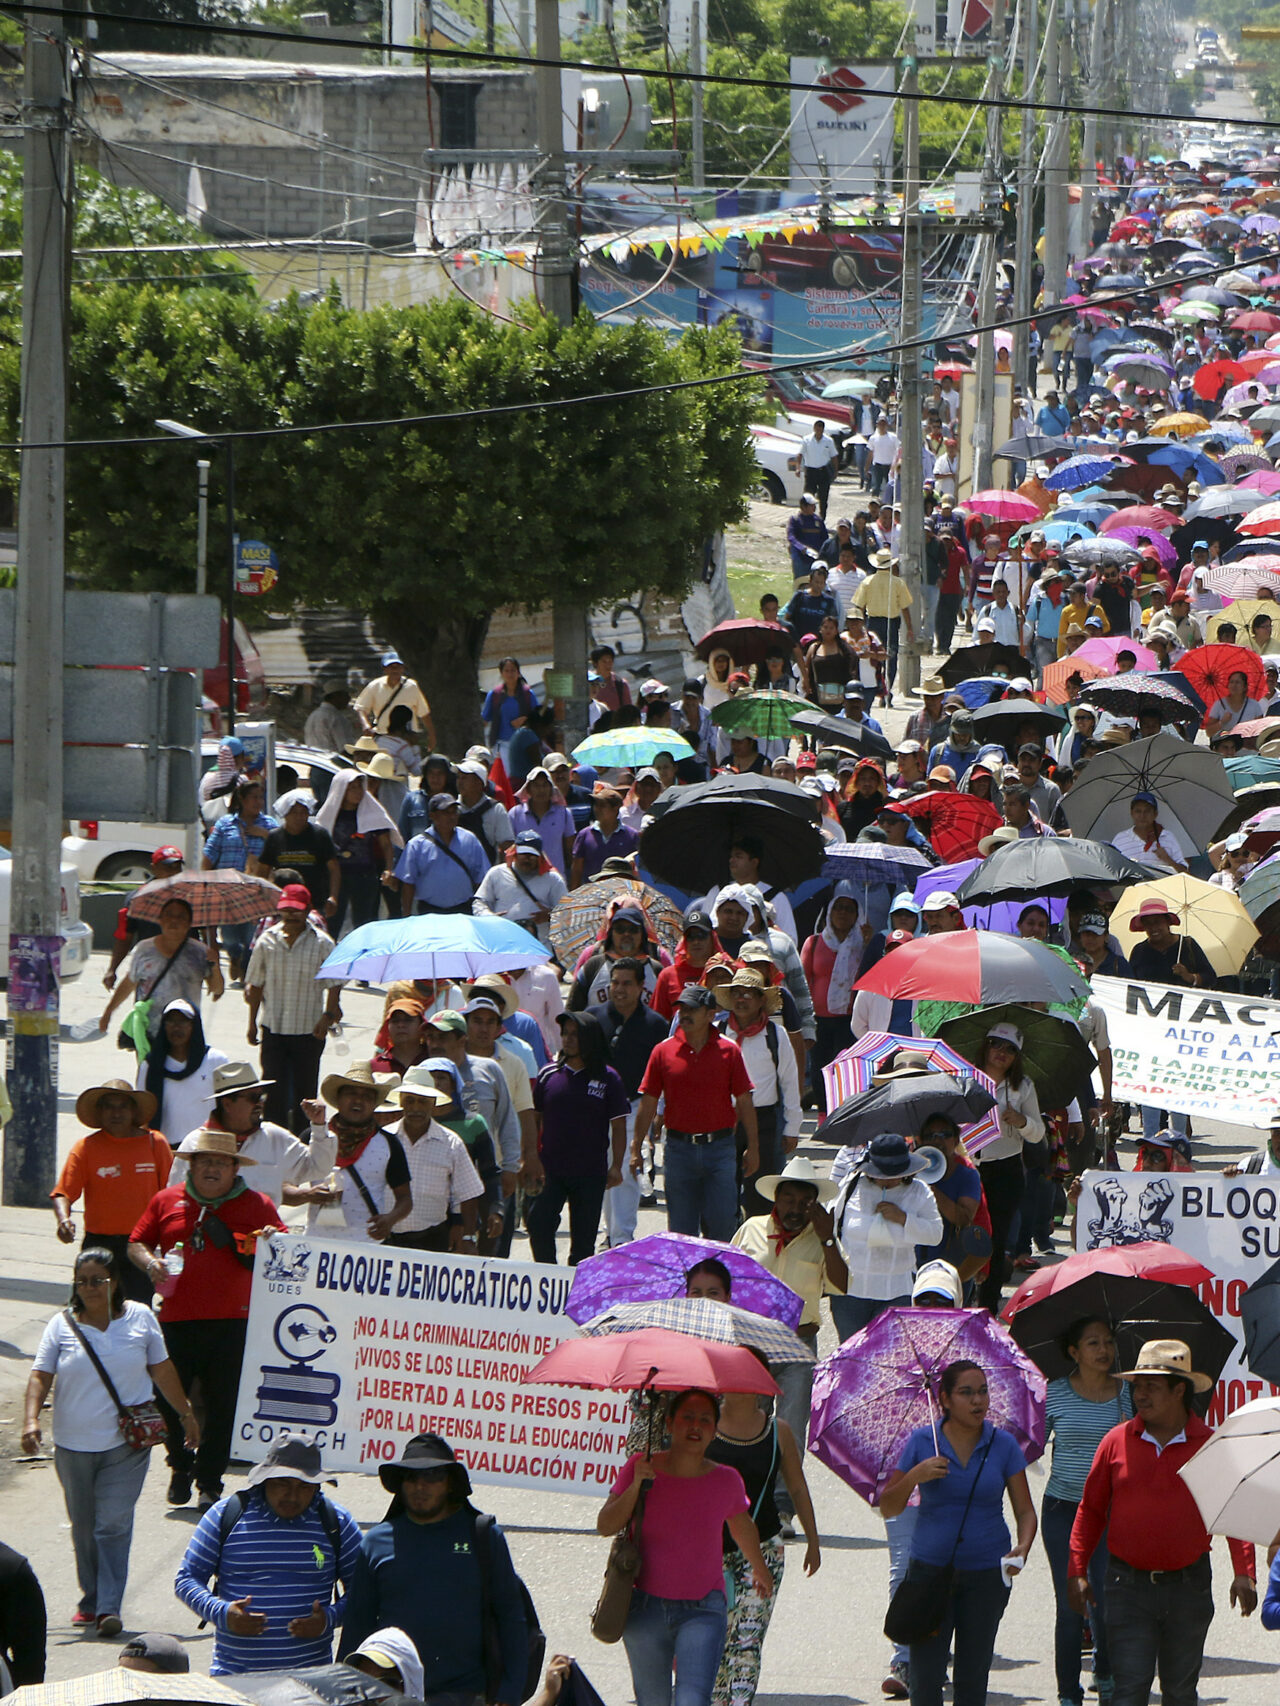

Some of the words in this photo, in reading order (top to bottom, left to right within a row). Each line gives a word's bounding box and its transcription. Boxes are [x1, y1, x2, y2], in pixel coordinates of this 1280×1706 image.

[816, 120, 867, 131] SUZUKI
[1165, 1027, 1215, 1043] ALTO
[1228, 1033, 1242, 1047] A
[1253, 1035, 1279, 1048] LA
[1178, 1044, 1209, 1058] DE
[1221, 1049, 1254, 1063] LA
[1151, 1056, 1182, 1070] LA
[268, 1282, 302, 1295] UDES
[316, 1251, 394, 1297] BLOQUE
[396, 1261, 533, 1312] DEMOCRÁTICO
[353, 1315, 377, 1340] ¡NO
[379, 1318, 390, 1339] A
[393, 1319, 409, 1342] LA
[413, 1322, 530, 1354] CRIMINALIZACIÓN
[534, 1335, 552, 1356] DE
[355, 1346, 401, 1370] ¡VIVOS
[404, 1351, 422, 1373] SE
[425, 1353, 453, 1376] LOS
[456, 1358, 530, 1383] LLEVARON
[357, 1376, 448, 1405] ¡LIBERTAD
[453, 1388, 465, 1408] A
[471, 1389, 505, 1412] LOS
[511, 1393, 581, 1419] PRESOS
[241, 1422, 346, 1451] COCH
[360, 1407, 394, 1432] ¡POR
[397, 1411, 415, 1433] LA
[419, 1414, 483, 1441] DEFENSA
[487, 1421, 506, 1443] DE
[509, 1423, 528, 1445] LA
[532, 1427, 614, 1455] EDUCACIÓN
[360, 1439, 396, 1463] ¡NO
[454, 1448, 576, 1481] EVALUACIÓN
